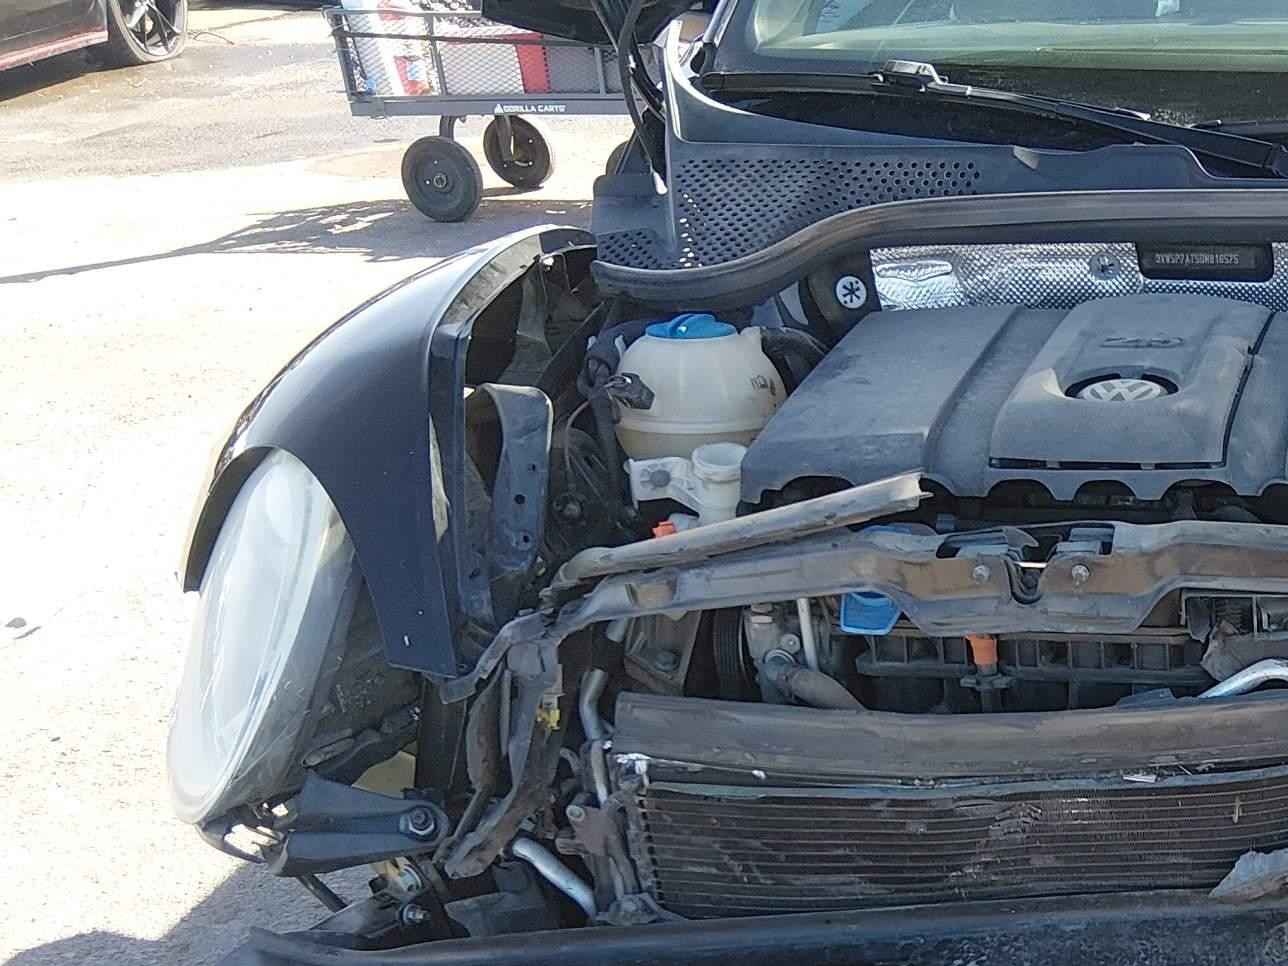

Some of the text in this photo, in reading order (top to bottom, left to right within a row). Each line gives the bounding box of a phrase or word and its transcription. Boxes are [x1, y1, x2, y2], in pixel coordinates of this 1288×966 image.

[503, 104, 566, 113] GORILLA CARTS
[1082, 378, 1162, 401] VW
